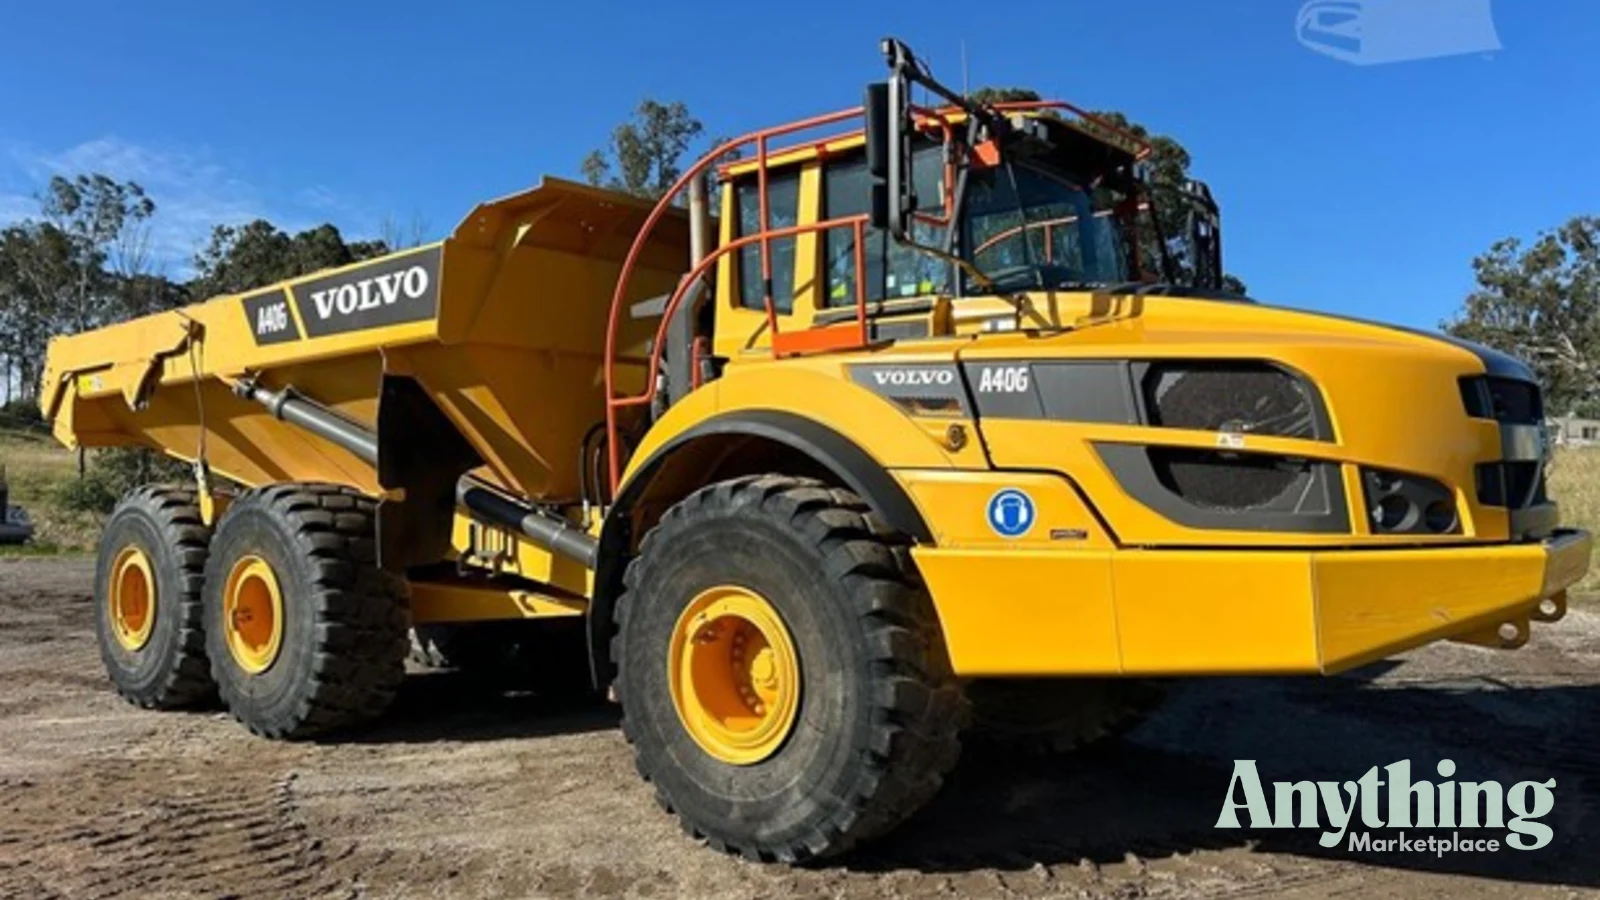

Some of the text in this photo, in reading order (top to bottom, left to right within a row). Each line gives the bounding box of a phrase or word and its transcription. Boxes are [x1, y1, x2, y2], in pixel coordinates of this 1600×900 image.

[310, 265, 429, 320] VOLVO
[257, 302, 288, 335] A40G
[872, 369, 954, 385] VOLVO
[979, 367, 1029, 393] A40G
